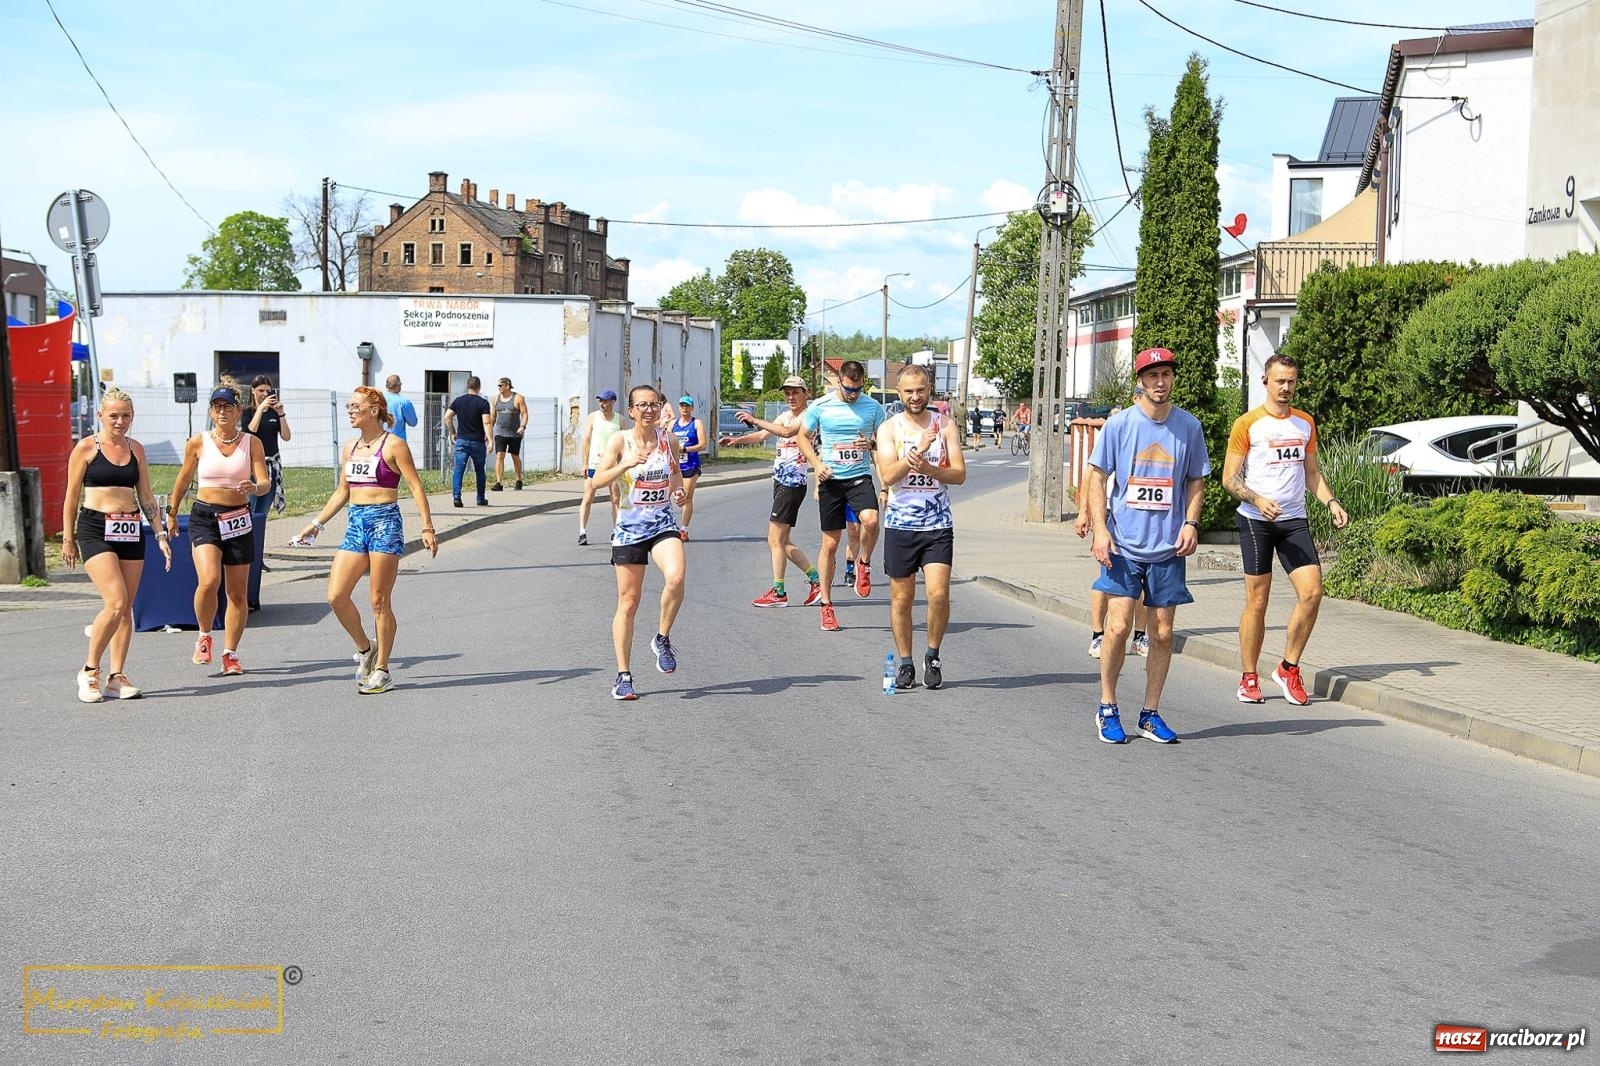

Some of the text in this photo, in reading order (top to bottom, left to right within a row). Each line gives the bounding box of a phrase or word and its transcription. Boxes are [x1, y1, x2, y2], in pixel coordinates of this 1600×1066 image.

[1528, 175, 1575, 224] Zamkowa 9
[412, 299, 442, 309] TRWA
[404, 309, 489, 321] Sekcja Podnoszenia
[839, 450, 858, 460] 166
[1276, 448, 1300, 460] 144
[351, 463, 370, 475] 192
[908, 475, 934, 487] 233
[641, 489, 665, 502] 232
[1137, 487, 1163, 502] 216
[112, 522, 136, 534] 200
[227, 516, 246, 531] 123
